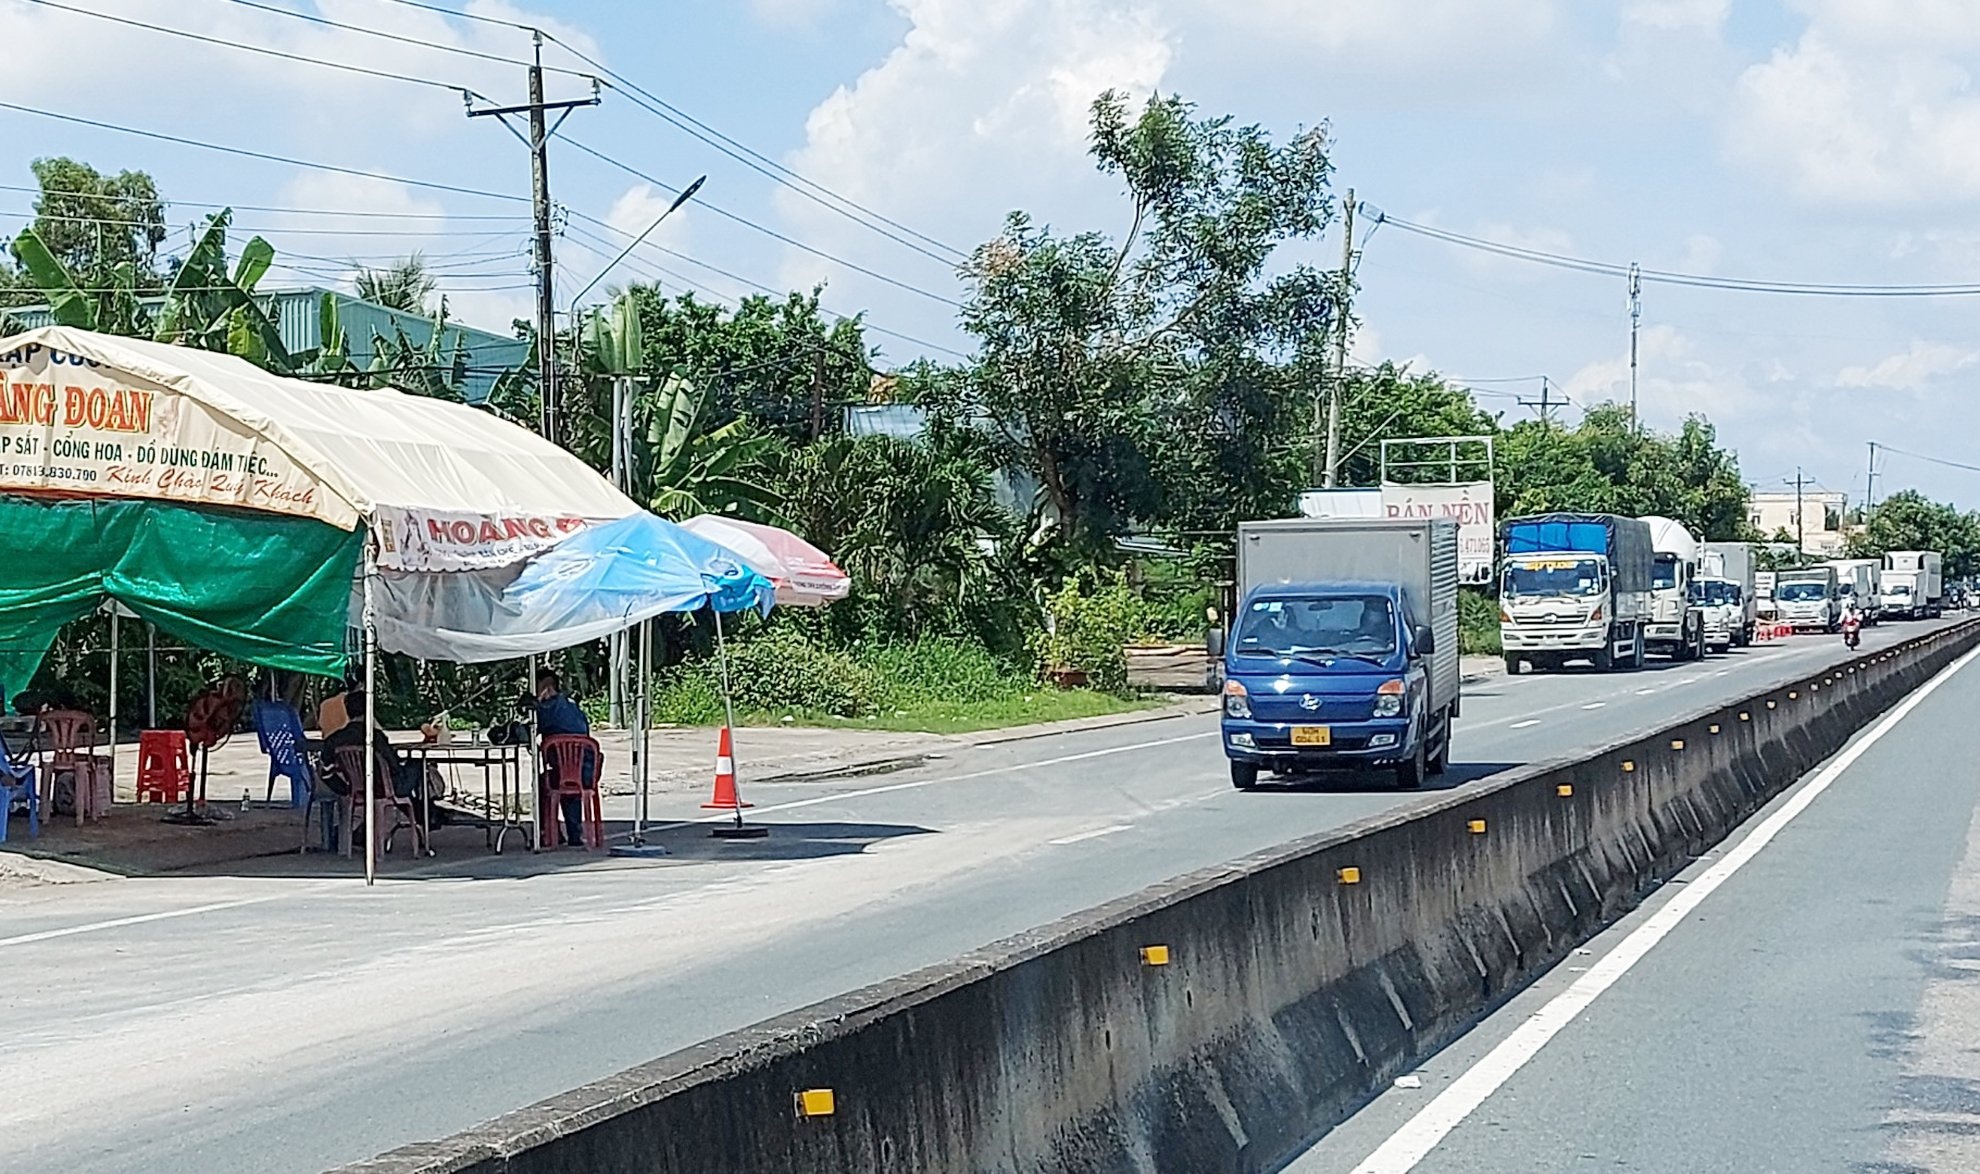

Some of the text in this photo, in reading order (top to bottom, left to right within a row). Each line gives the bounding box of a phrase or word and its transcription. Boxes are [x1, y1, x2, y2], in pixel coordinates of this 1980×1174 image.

[0, 342, 41, 369] ẠP
[64, 386, 154, 434] ĐOAN
[15, 429, 39, 455] SẮT
[53, 430, 90, 459] CỔNG
[95, 442, 122, 461] HOA
[160, 443, 198, 467] DÙNG
[201, 446, 233, 472] ĐÁM
